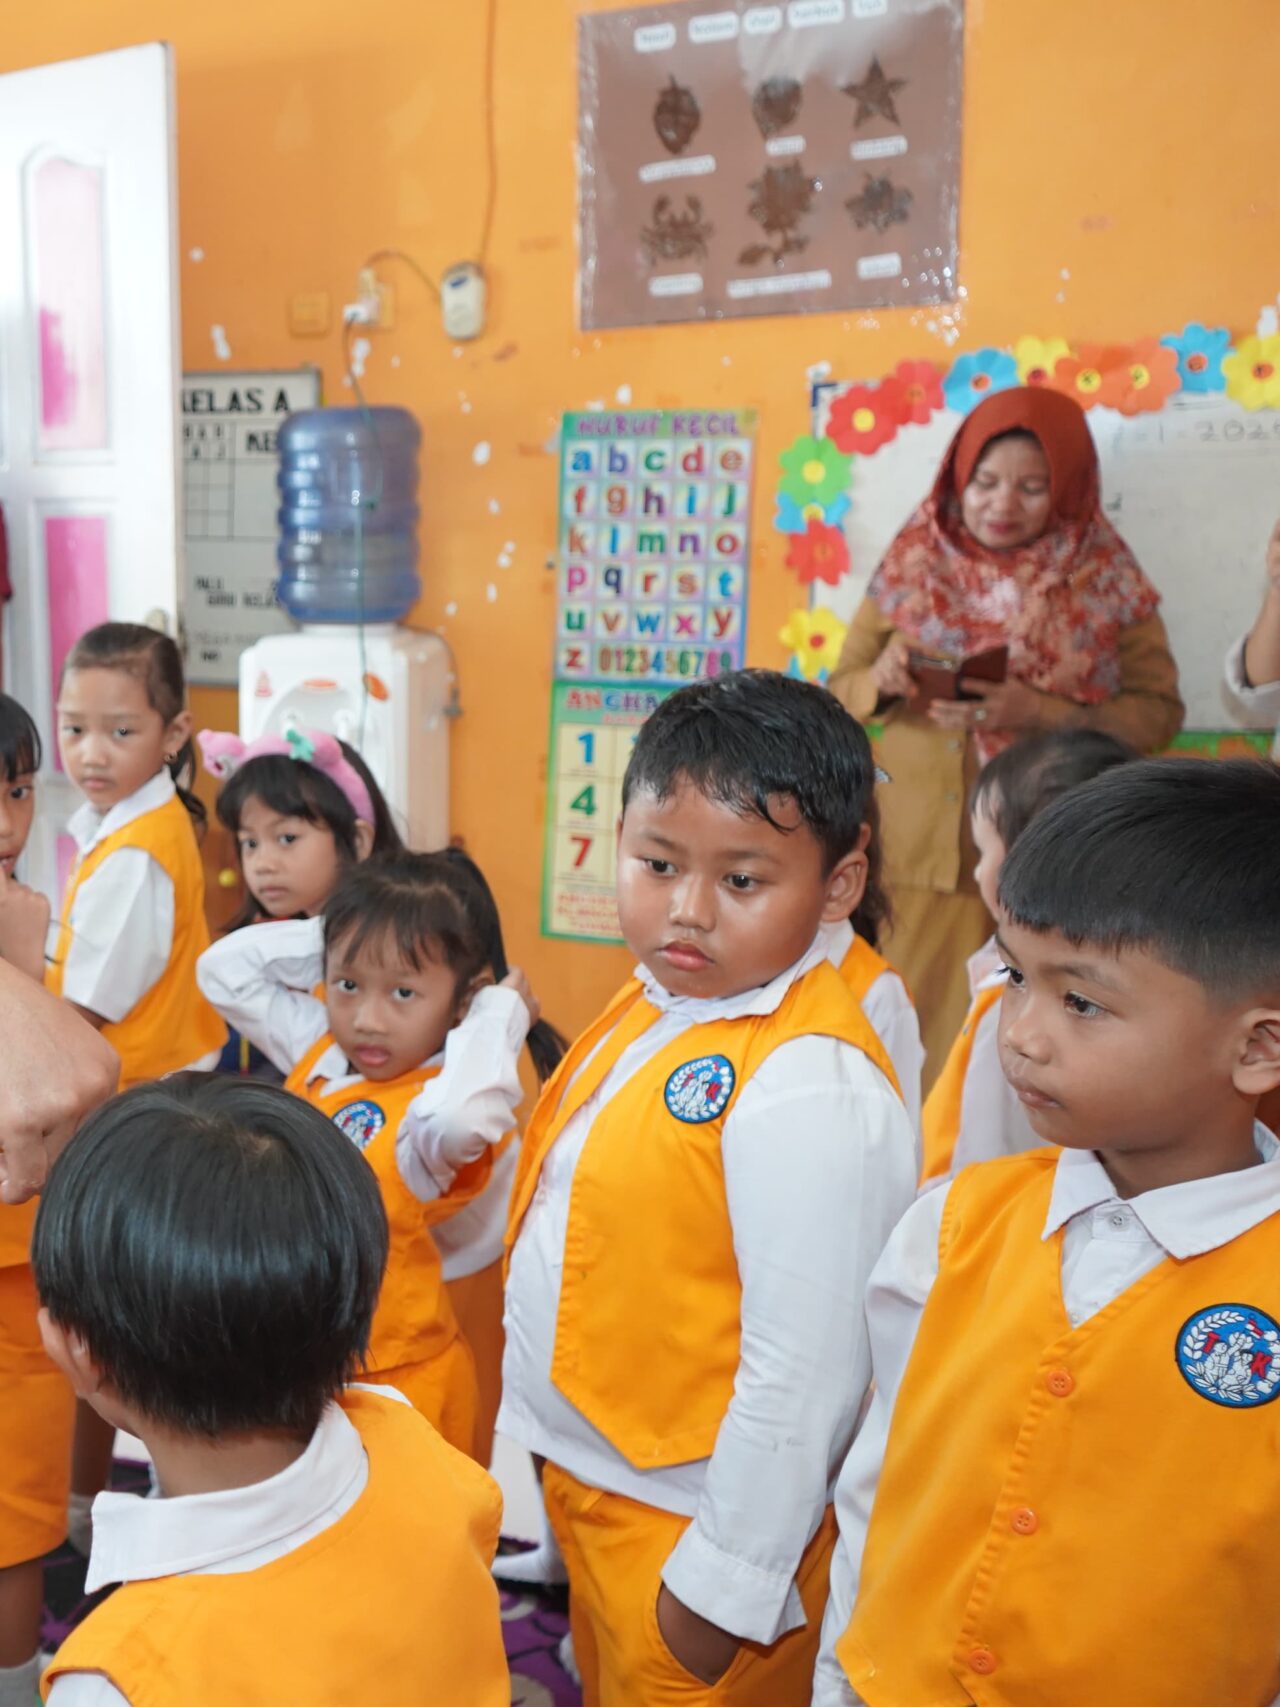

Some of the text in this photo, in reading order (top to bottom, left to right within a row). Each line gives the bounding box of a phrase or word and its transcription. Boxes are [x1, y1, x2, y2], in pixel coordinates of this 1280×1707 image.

[183, 387, 289, 413] ELAS A
[571, 445, 742, 473] a b c d e
[575, 486, 586, 514] f
[607, 486, 626, 516] g
[644, 486, 664, 515] h
[568, 526, 586, 553] k
[638, 533, 666, 553] m
[679, 533, 699, 553] n
[716, 533, 738, 553] o
[567, 567, 733, 597] p q r s t
[566, 608, 733, 637] u v w x y
[566, 648, 582, 668] z
[578, 732, 595, 764] 1
[570, 785, 596, 816] 4
[570, 836, 593, 868] 7
[1203, 1331, 1273, 1379] T K
